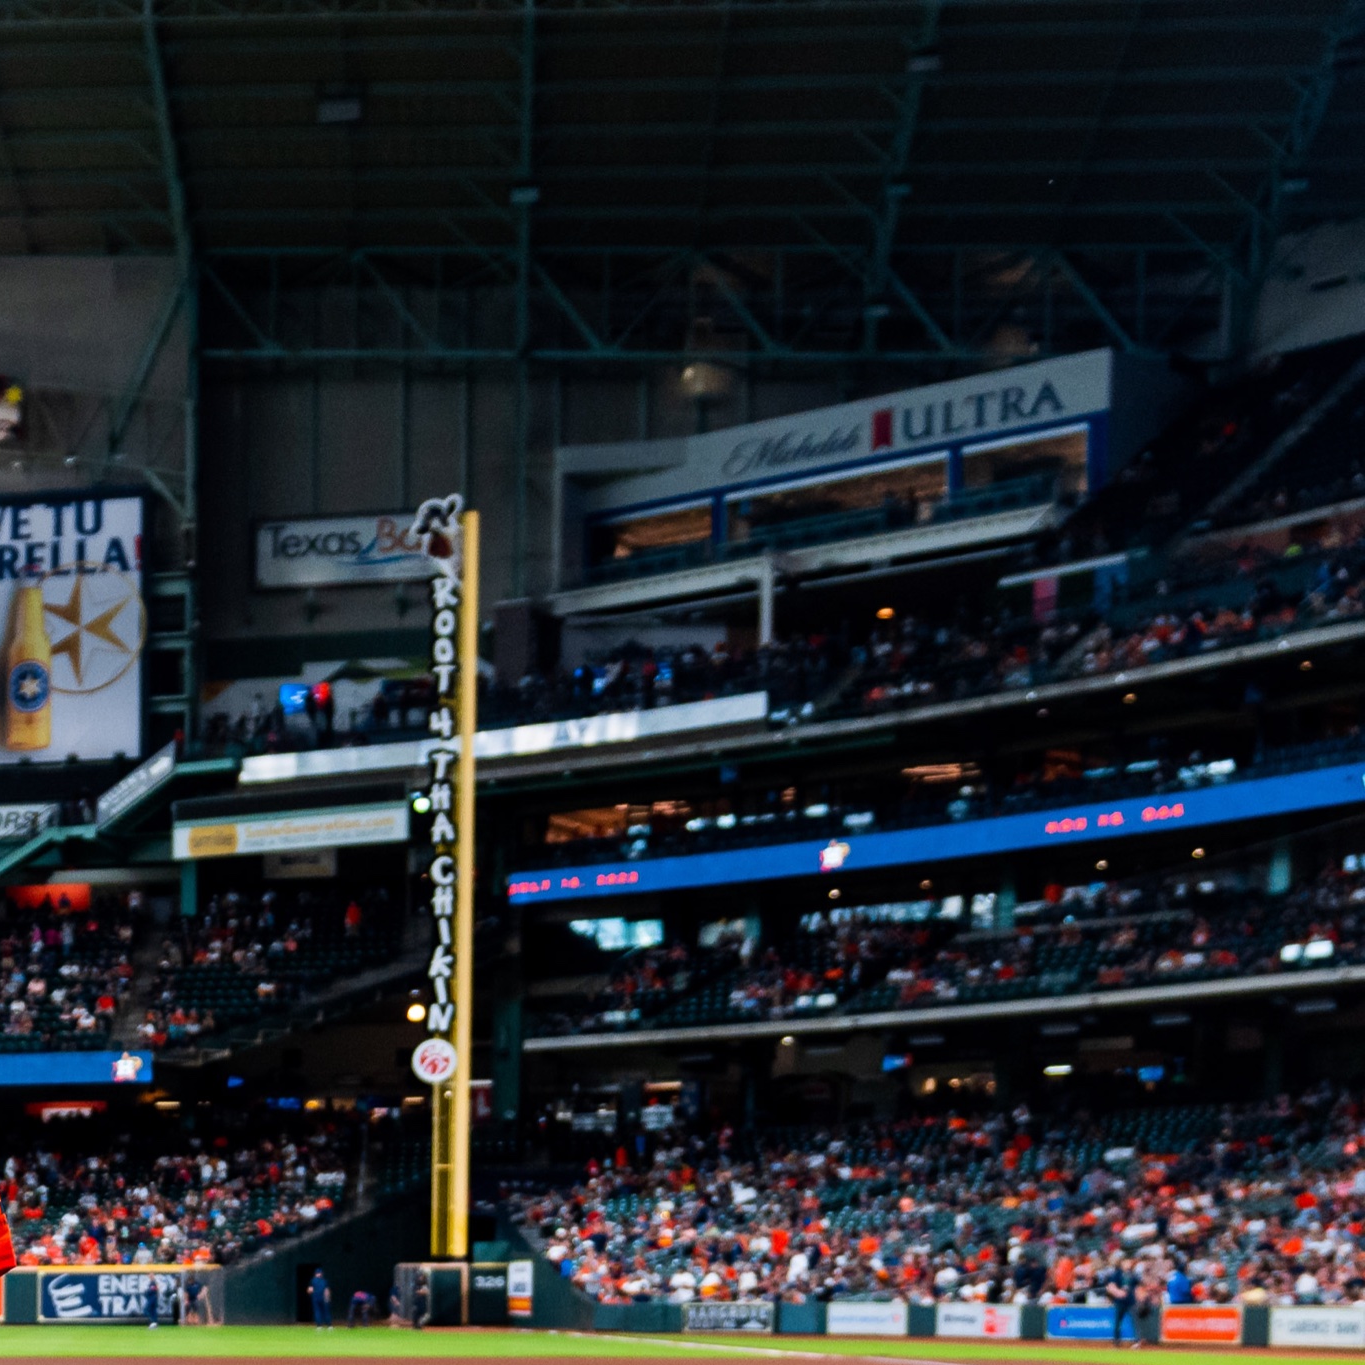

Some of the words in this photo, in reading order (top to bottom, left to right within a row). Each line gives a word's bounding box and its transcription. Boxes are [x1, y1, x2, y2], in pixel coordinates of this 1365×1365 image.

[902, 380, 1063, 440] ULTRA
[50, 499, 105, 537] TU
[266, 525, 360, 559] Texas
[378, 516, 423, 553] Ba
[431, 577, 459, 694] ROOT
[429, 706, 453, 739] 4
[429, 751, 455, 844] THA
[427, 855, 455, 1033] CHIKIN
[474, 1275, 506, 1289] 326
